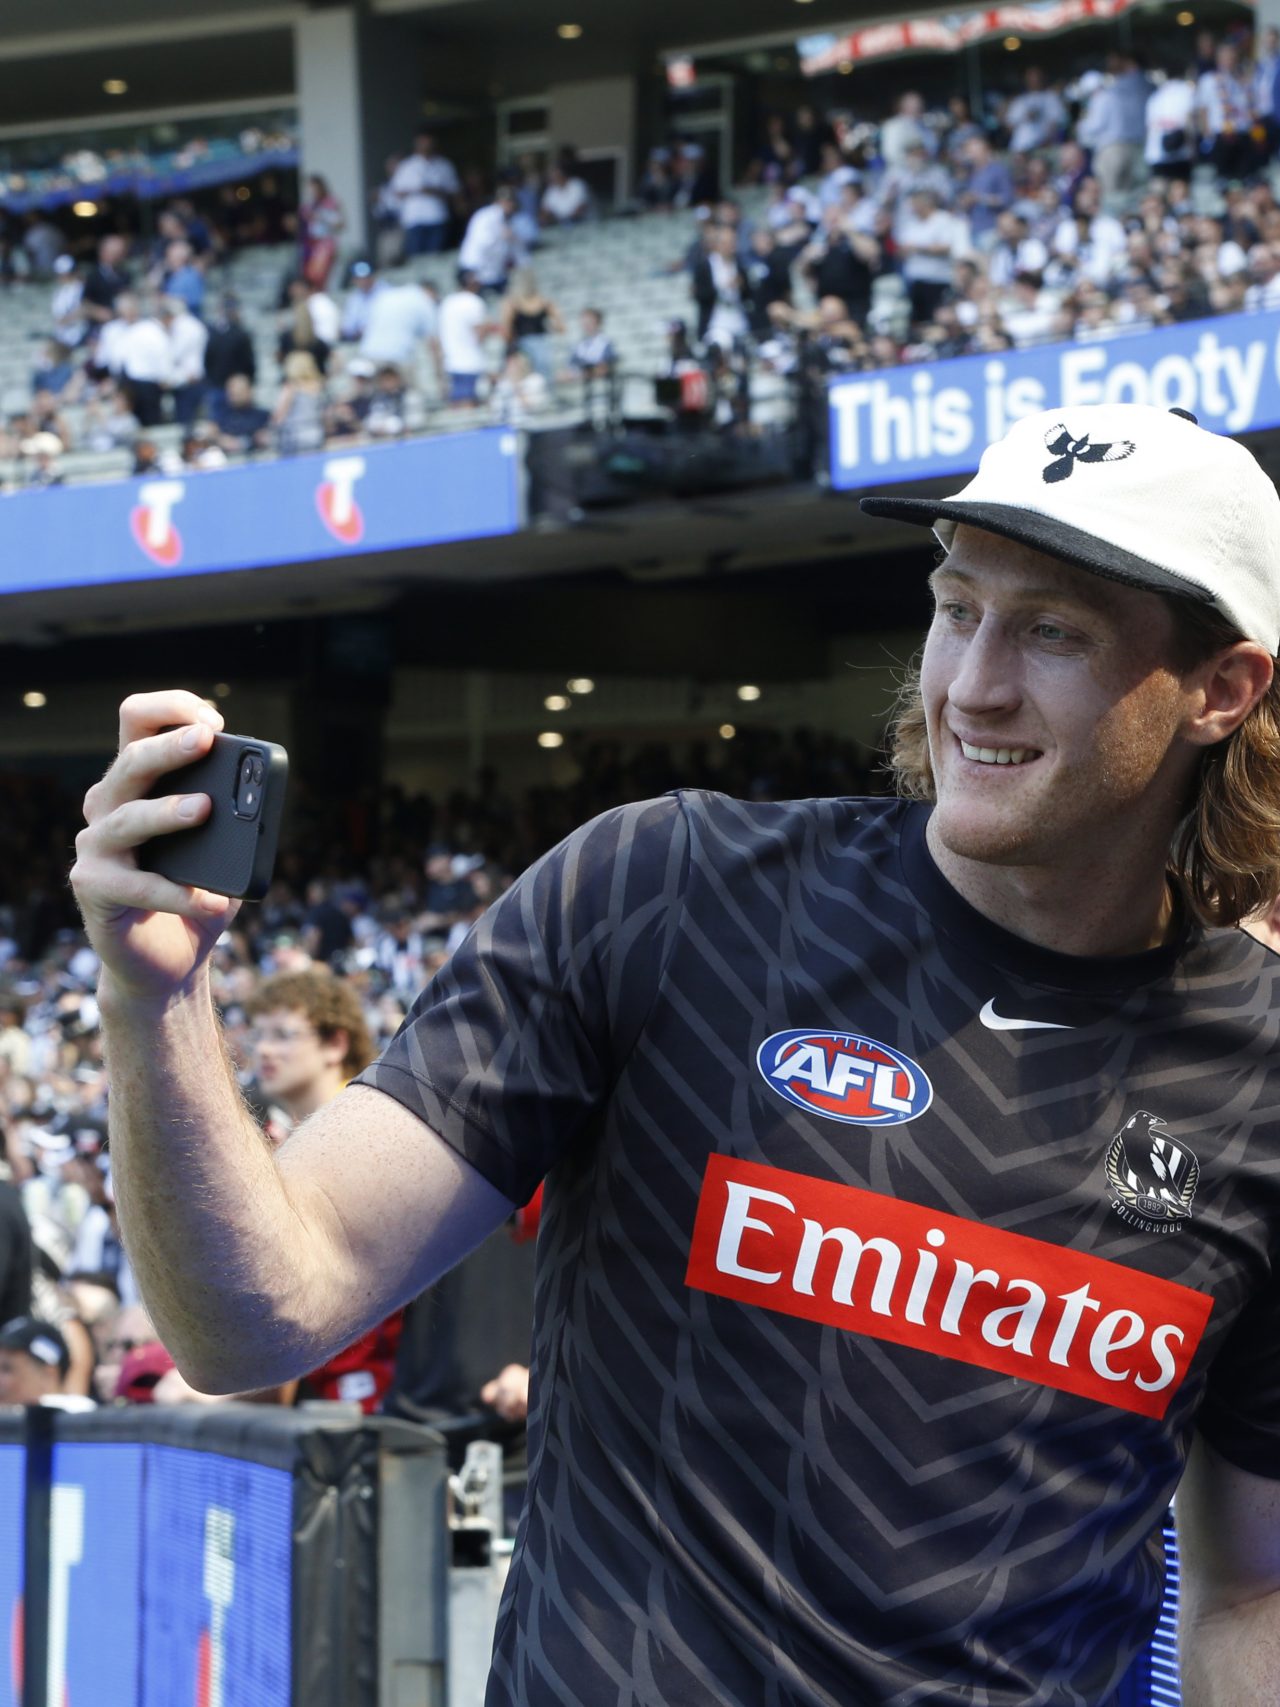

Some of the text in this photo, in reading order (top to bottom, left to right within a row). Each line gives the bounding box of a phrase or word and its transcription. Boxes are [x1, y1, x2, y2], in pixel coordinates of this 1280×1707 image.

[828, 370, 975, 469] This
[1060, 332, 1267, 432] Footy
[770, 1042, 912, 1114] AFL
[1111, 1199, 1182, 1234] COLLINGWOOD
[1143, 1199, 1161, 1213] 1892
[716, 1180, 1185, 1393] Emirates
